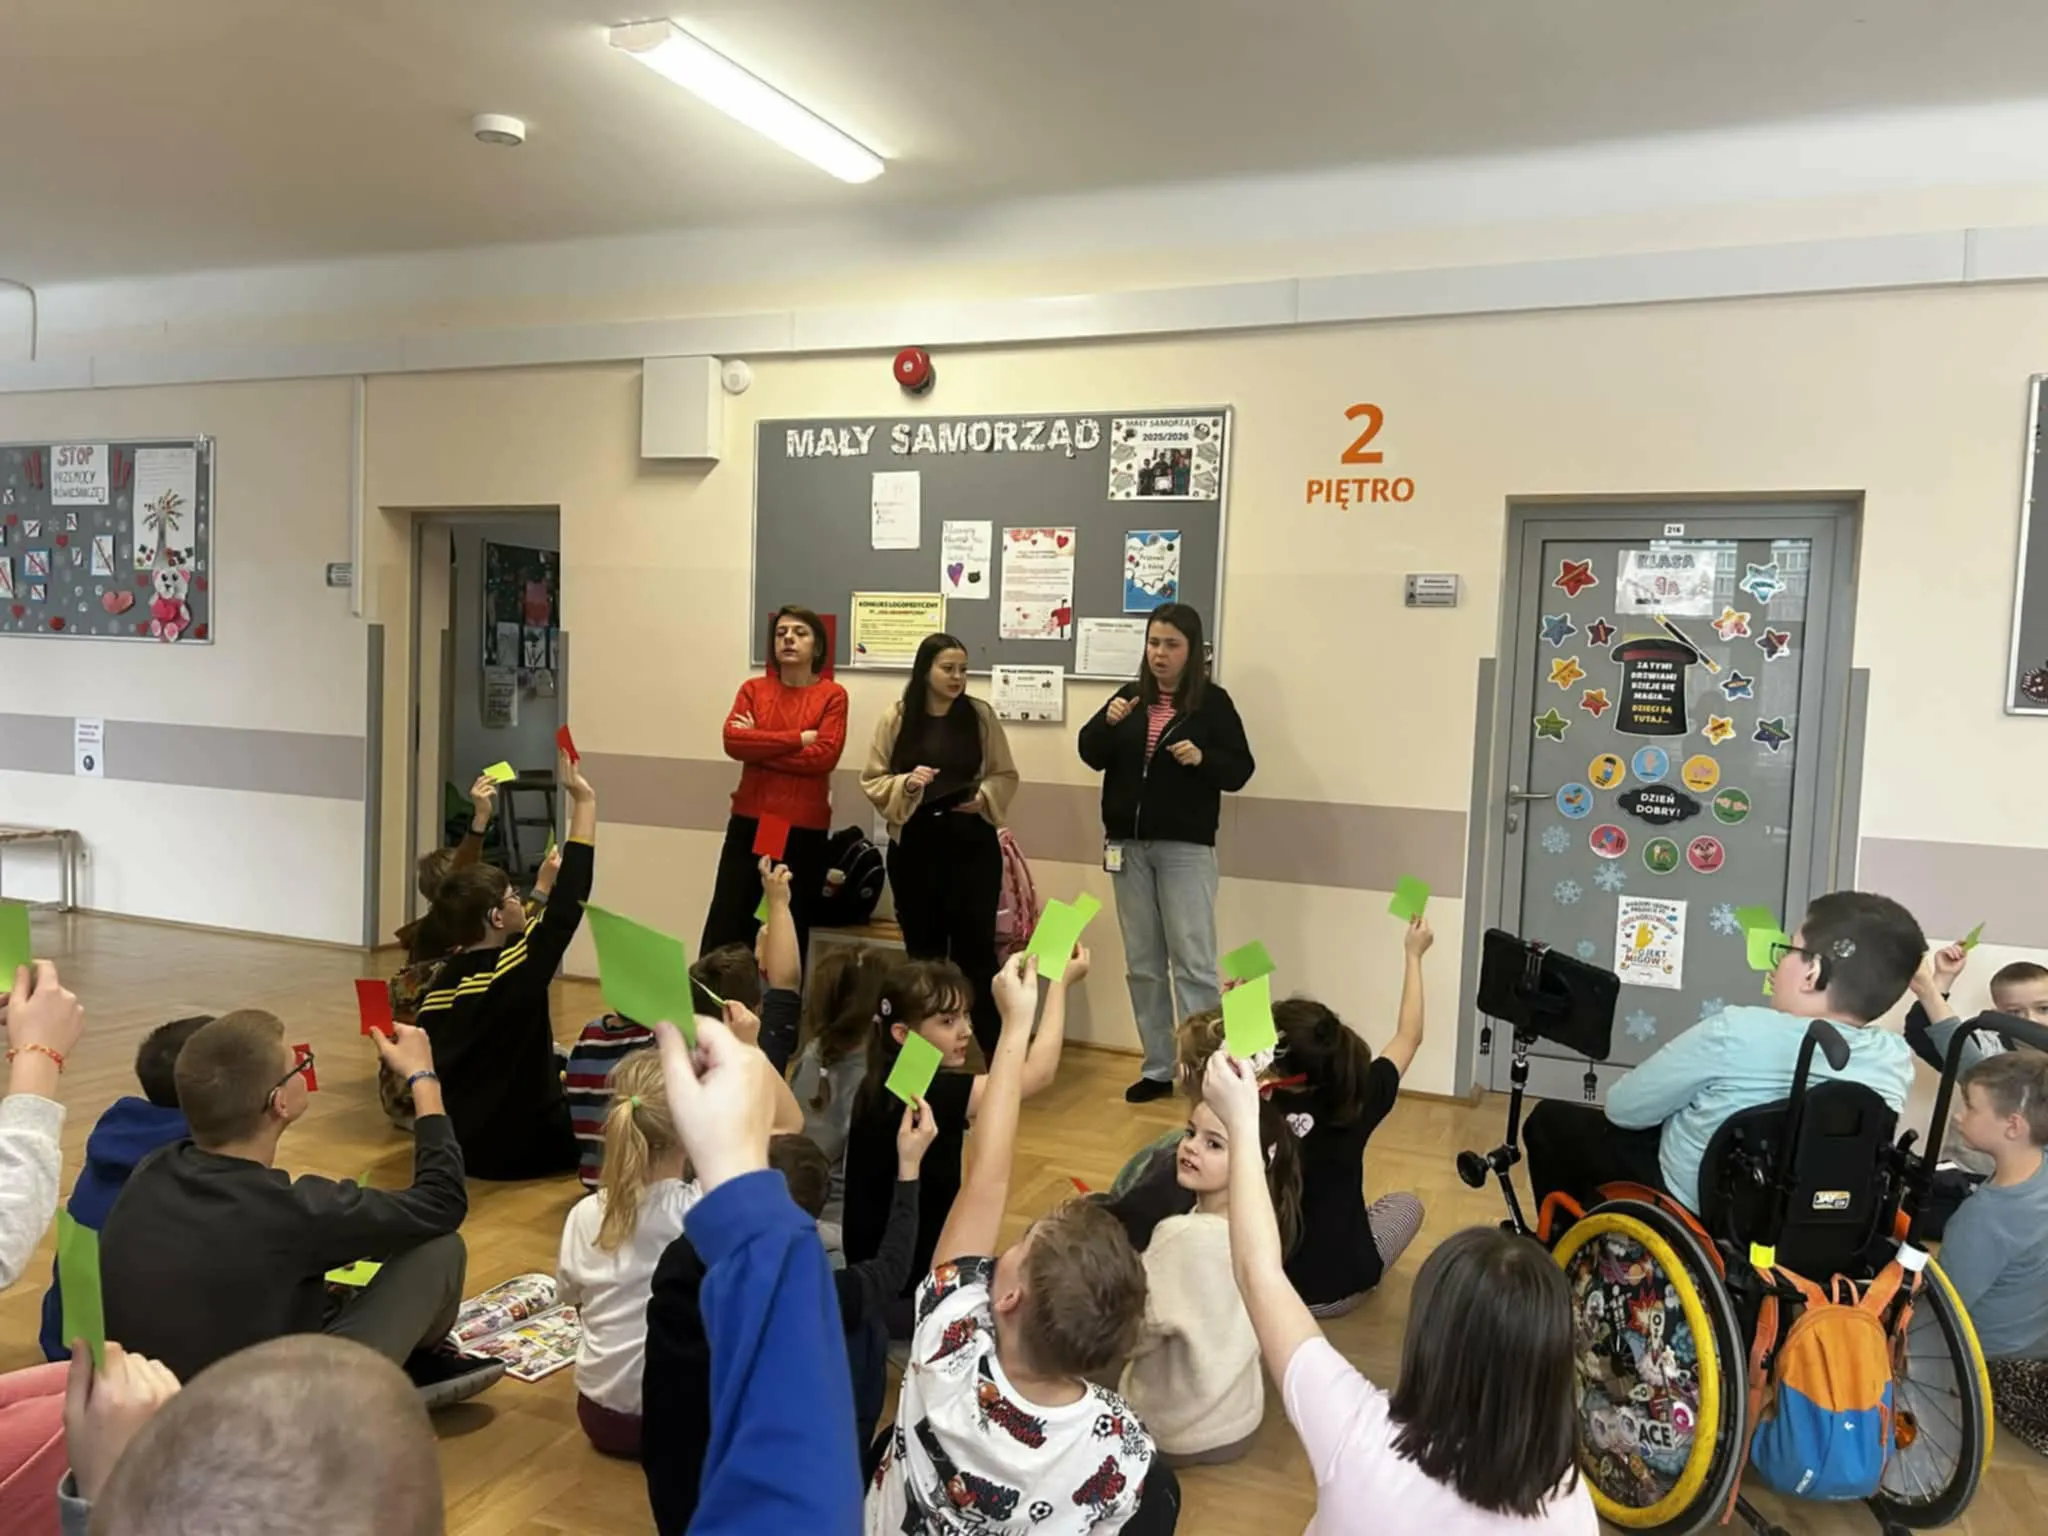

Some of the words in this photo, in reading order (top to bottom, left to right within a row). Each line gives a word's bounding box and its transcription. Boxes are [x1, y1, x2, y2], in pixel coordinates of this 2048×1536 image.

[785, 424, 877, 458] MAŁY
[890, 417, 1101, 459] SAMORZĄD
[1142, 432, 1189, 441] 2025/2026
[1341, 403, 1384, 464] 2
[57, 446, 95, 467] STOP
[1306, 477, 1415, 511] PIĘTRO
[1637, 554, 1696, 569] KLASA
[1636, 661, 1649, 670] ZA
[1650, 662, 1673, 671] TYMI
[1631, 671, 1678, 681] DRZWIAMI
[1631, 682, 1660, 690] DZIEJE
[1661, 683, 1676, 692] SIĘ
[1631, 704, 1660, 713] DZIECI
[1640, 791, 1676, 805] DZIEŃ
[1635, 804, 1681, 817] DOBRY!
